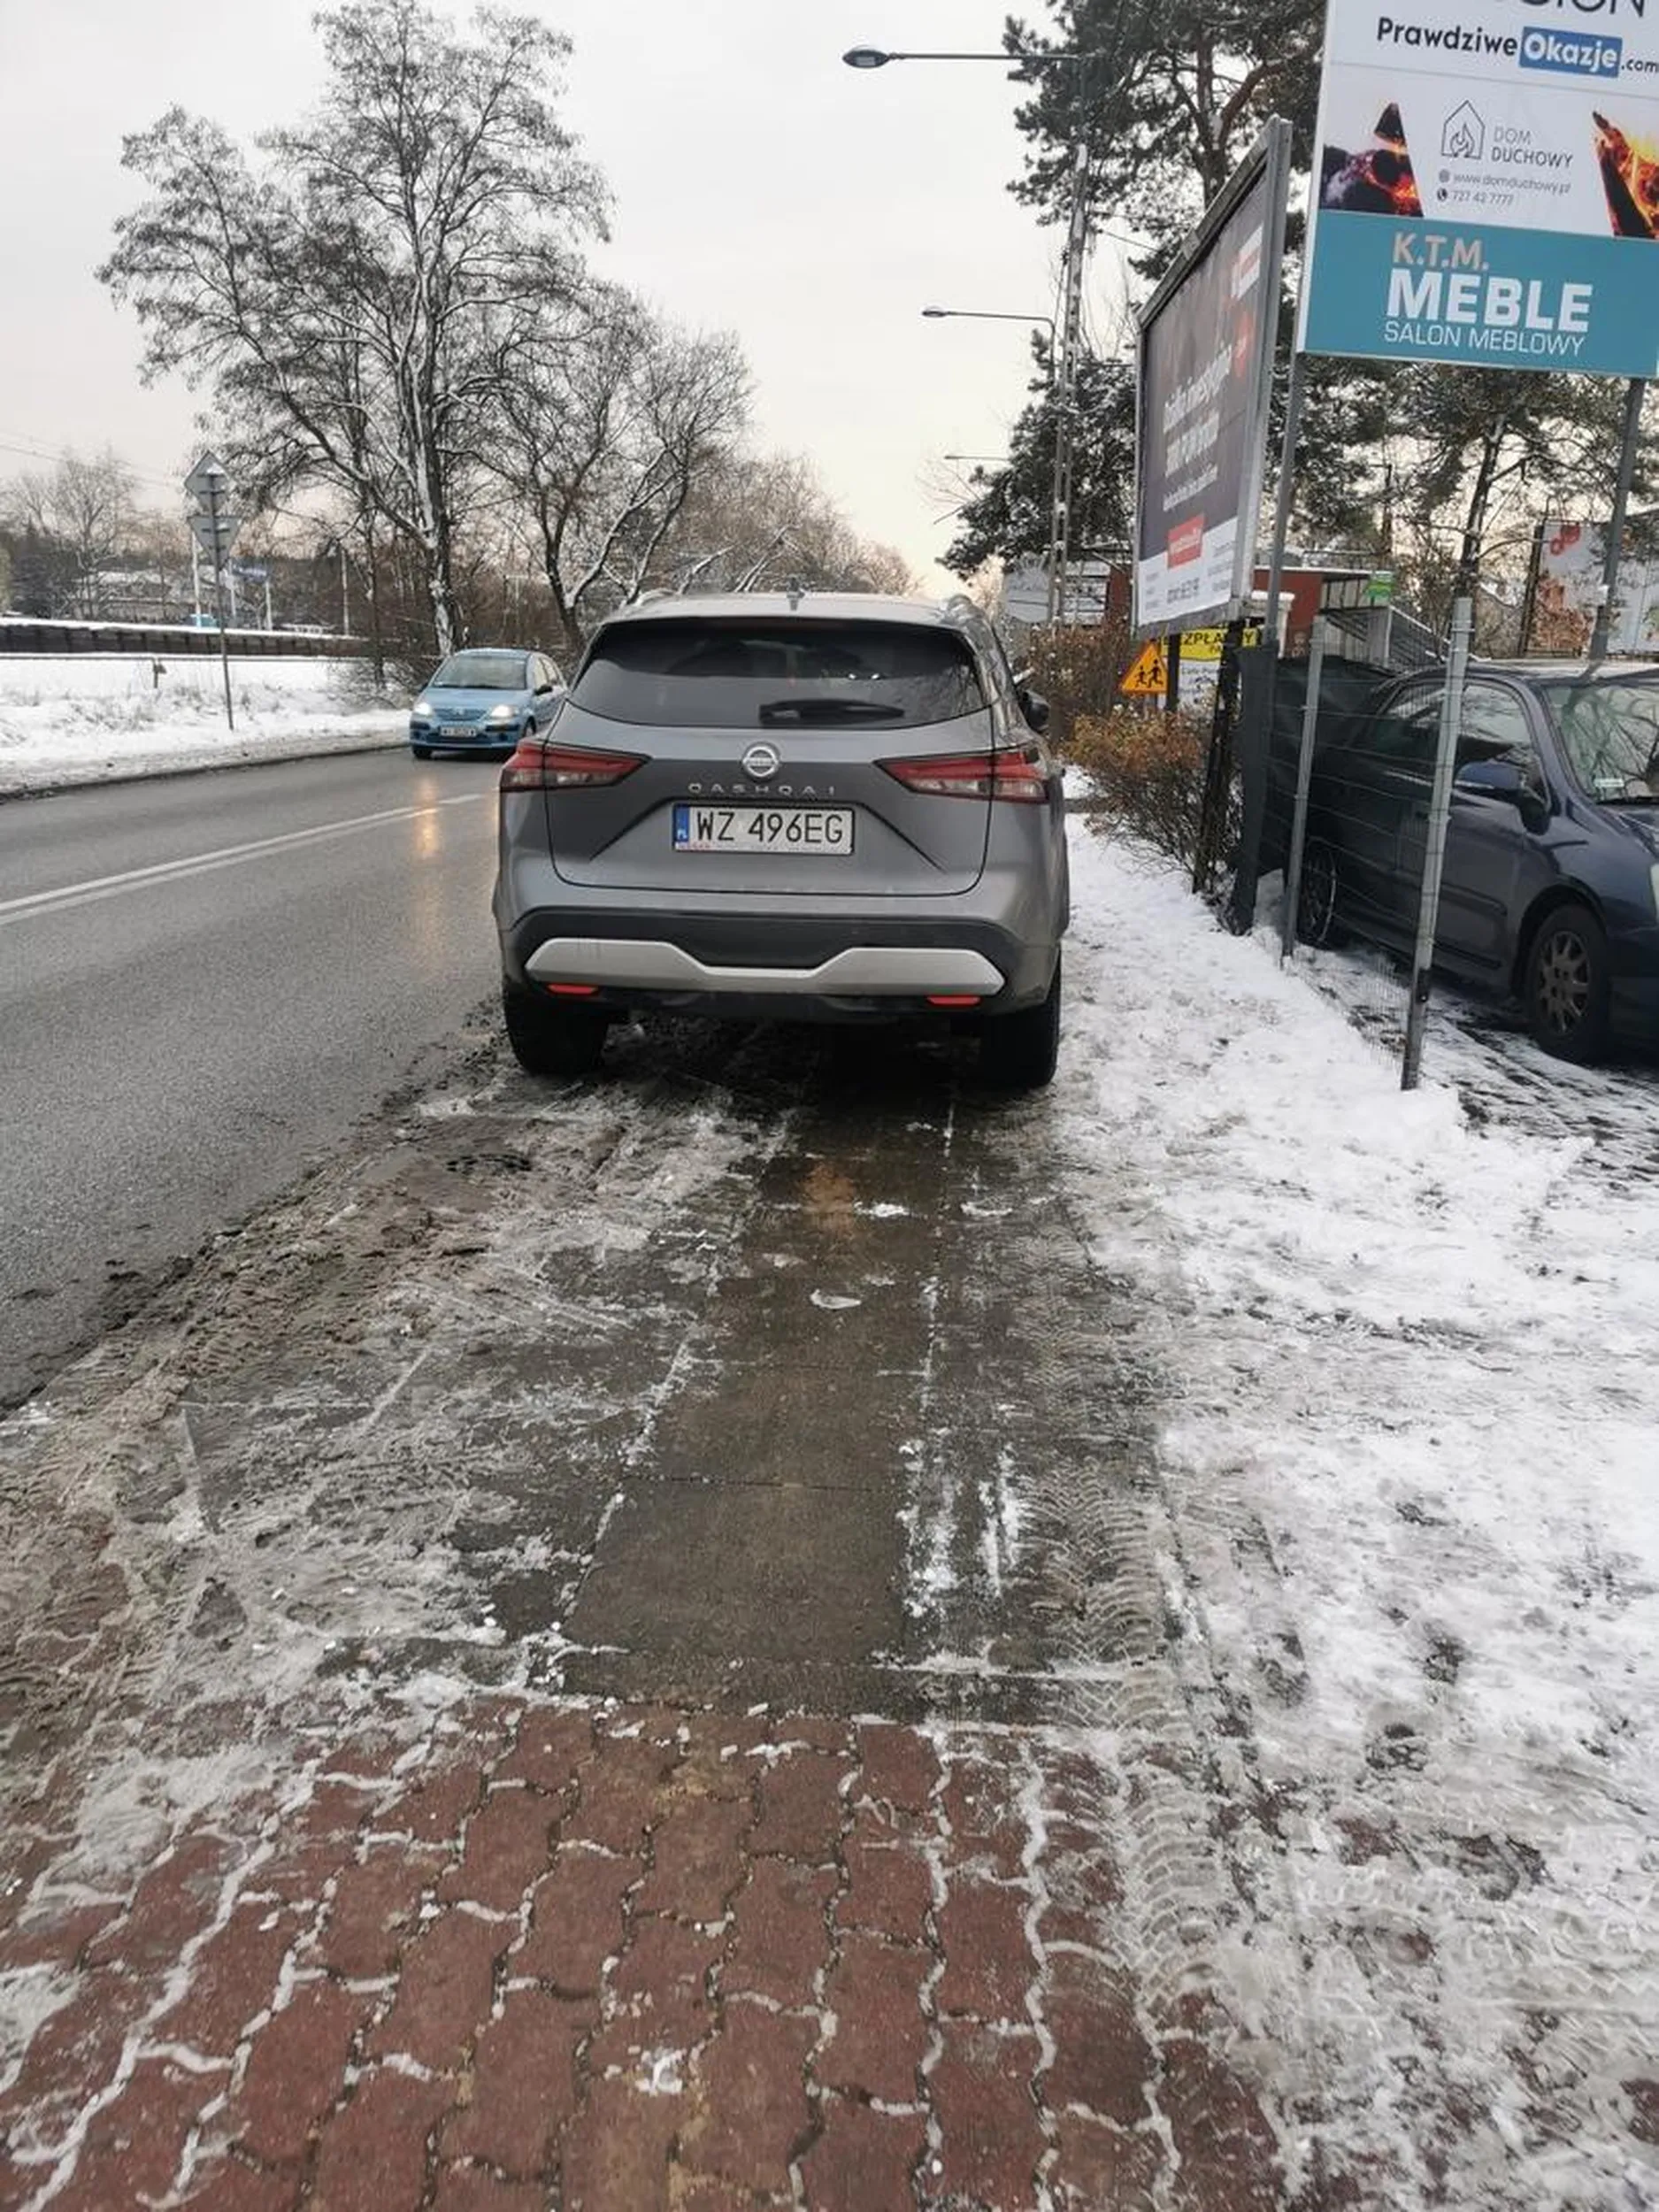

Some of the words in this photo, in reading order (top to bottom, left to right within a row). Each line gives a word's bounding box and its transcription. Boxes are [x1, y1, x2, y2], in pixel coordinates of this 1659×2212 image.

[1493, 126, 1532, 145] DOM
[1490, 146, 1573, 168] DUCHOWY
[1392, 231, 1490, 271] K.T.M.
[1386, 267, 1594, 334] MEBLE
[1384, 319, 1461, 348] SALON
[1468, 328, 1586, 357] MEBLOWY
[687, 782, 835, 795] QASHQAI
[696, 810, 735, 841] WZ
[747, 812, 843, 844] 496EG
